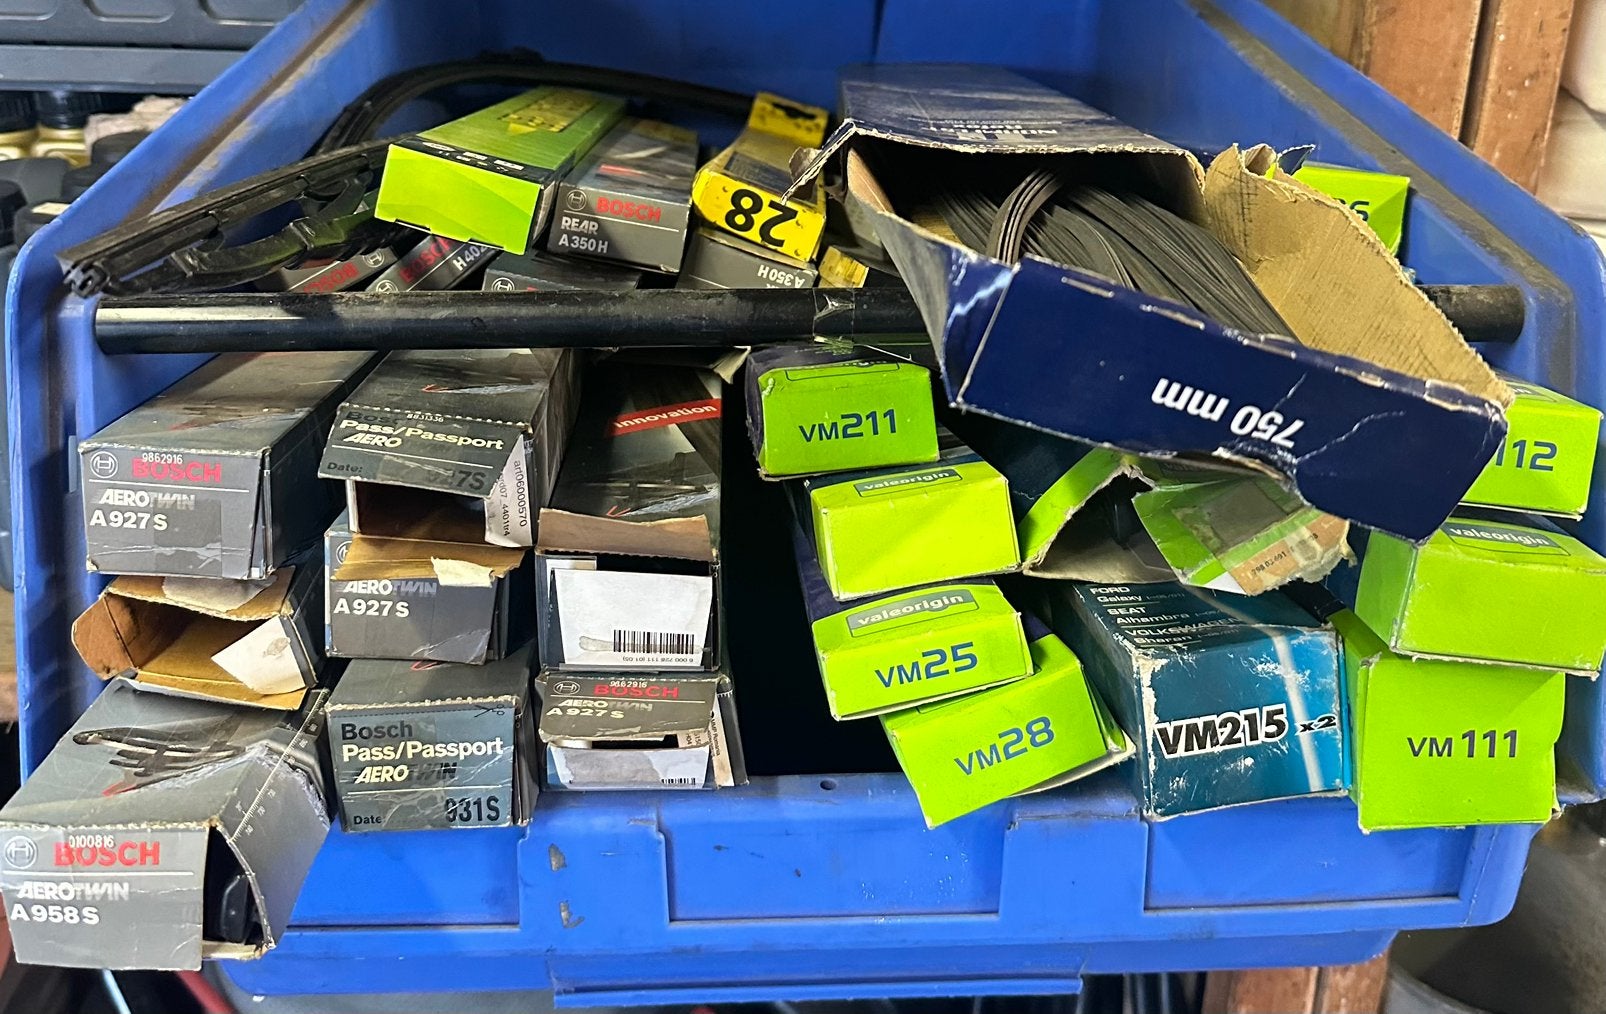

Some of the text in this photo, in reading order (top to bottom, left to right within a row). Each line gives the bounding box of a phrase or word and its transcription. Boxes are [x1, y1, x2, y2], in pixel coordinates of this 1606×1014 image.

[595, 197, 662, 223] BOSCH
[725, 189, 799, 248] 28
[560, 216, 599, 236] REAR
[1151, 377, 1305, 448] 750 mm
[339, 419, 505, 450] Pass/Passport
[798, 408, 897, 442] VM211
[142, 452, 183, 464] 9862916
[327, 462, 363, 474] Date:
[131, 459, 222, 483] BOSCH
[863, 470, 950, 491] valeorigin
[98, 488, 195, 511] AEROTWIN
[1449, 528, 1550, 546] valeorigin
[343, 580, 438, 596] AEROTWIN
[1089, 586, 1131, 595] FORD
[1096, 595, 1143, 603] Galaxy
[857, 593, 964, 626] valeorigin
[1106, 606, 1147, 615] SEAT
[1116, 613, 1191, 624] Alhambra
[1133, 635, 1193, 645] Sharan
[875, 641, 978, 688] VM25
[593, 683, 680, 698] BOSCH
[557, 699, 653, 712] AEROTWIN
[341, 721, 413, 741] Bosch
[1155, 705, 1288, 757] VM215
[342, 737, 504, 762] Pass/Passport
[953, 716, 1055, 776] VM28
[68, 835, 115, 848] 0100816
[54, 842, 161, 866] BOSCH
[17, 881, 130, 901] AEROTWIN
